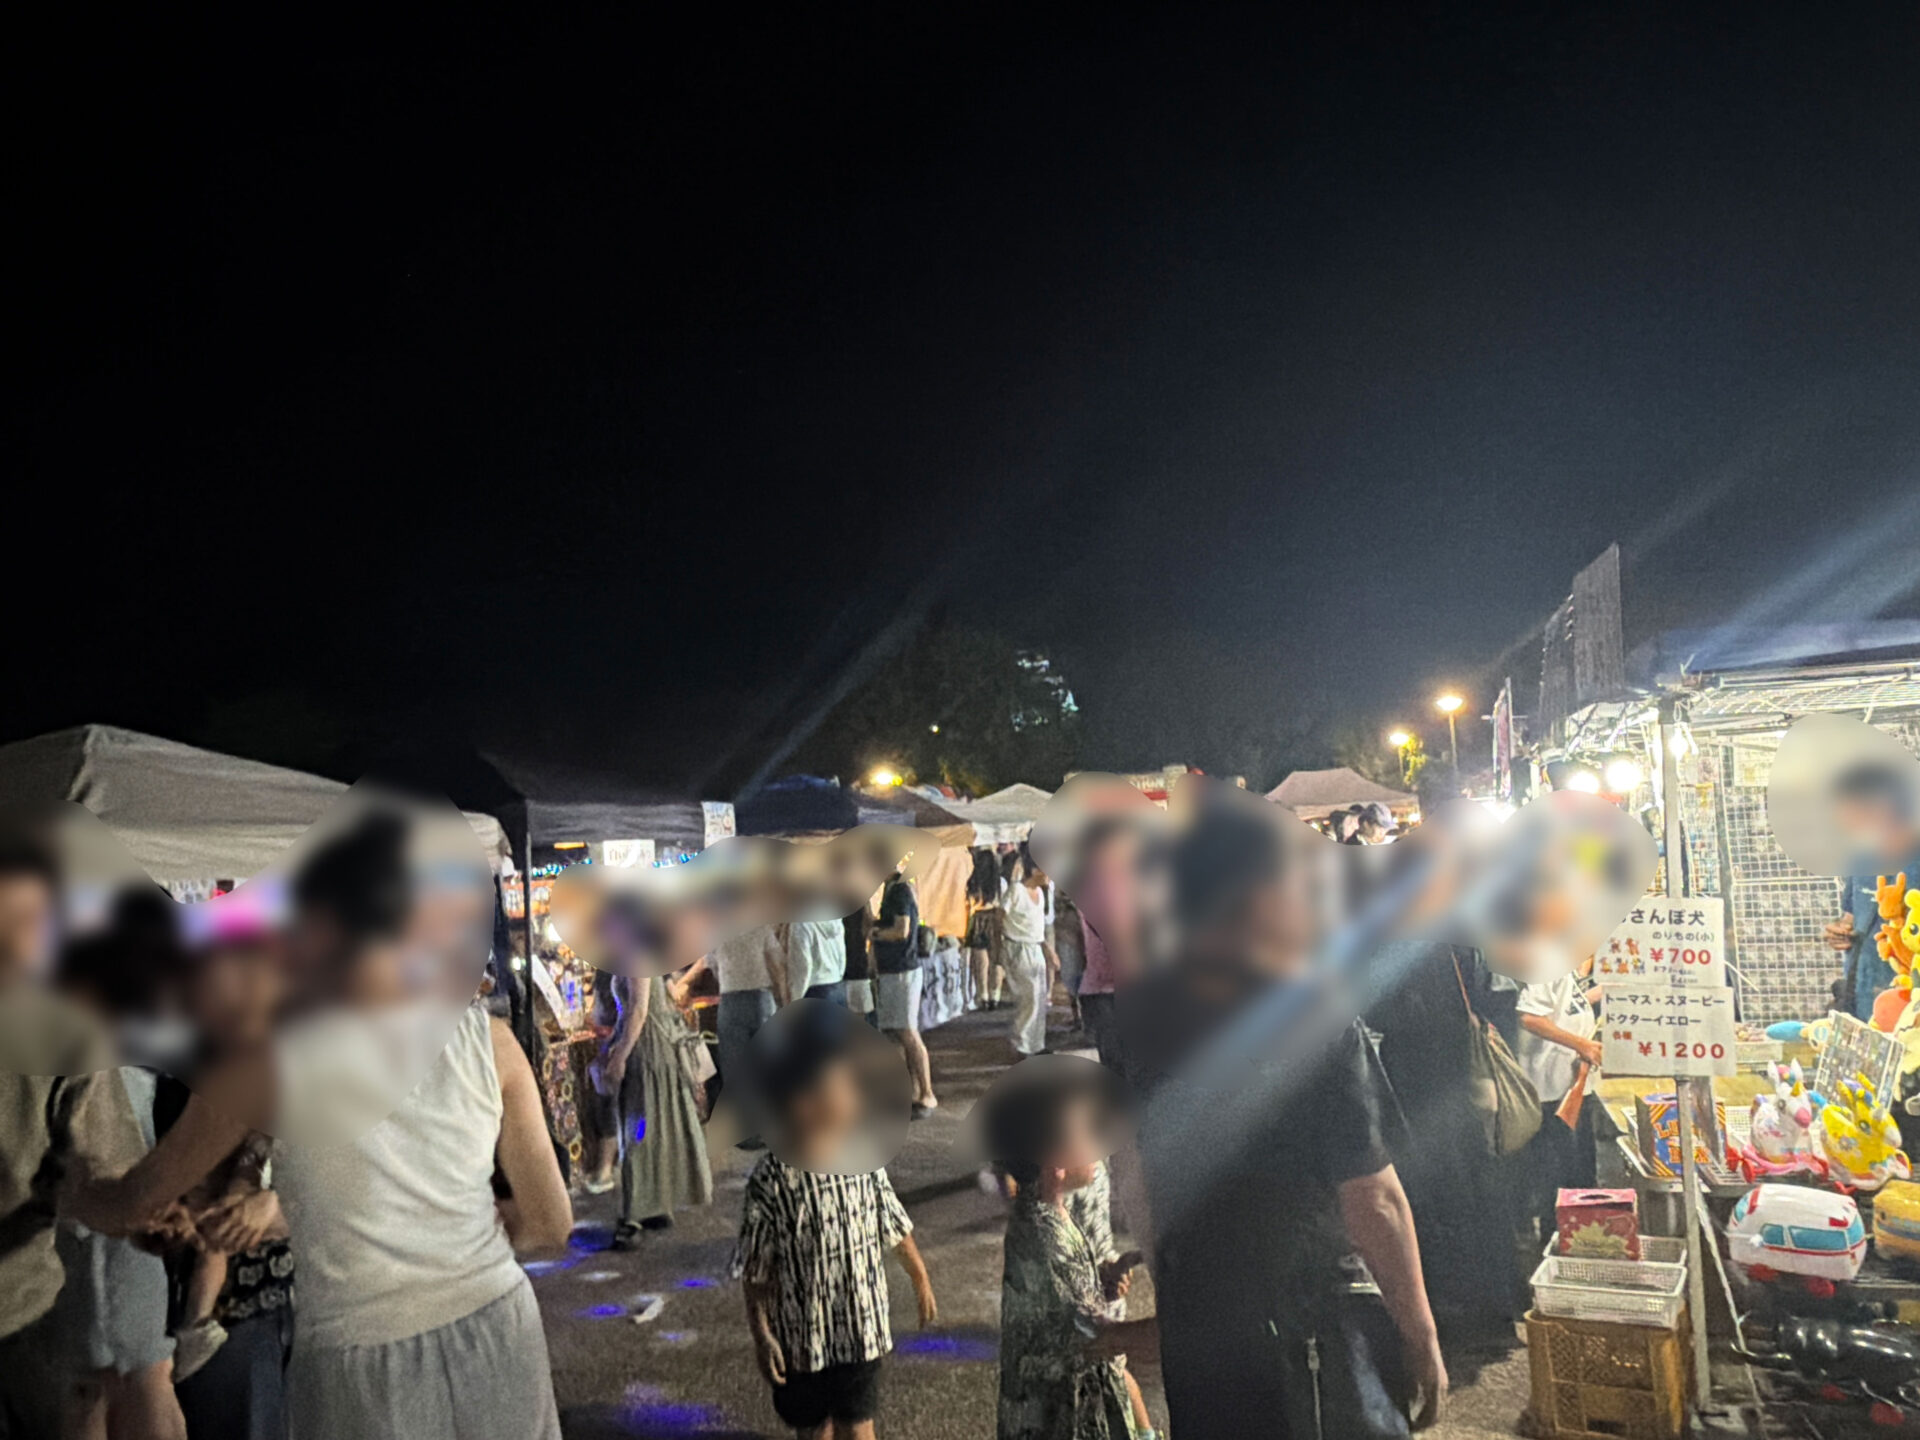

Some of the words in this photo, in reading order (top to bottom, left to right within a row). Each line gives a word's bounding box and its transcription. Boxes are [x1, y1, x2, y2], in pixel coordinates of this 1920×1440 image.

[1622, 908, 1704, 926] さんぽ犬
[1650, 948, 1711, 965] ¥700
[1606, 1013, 1701, 1026] ドクターイエロー
[1638, 1042, 1725, 1059] ¥1200
